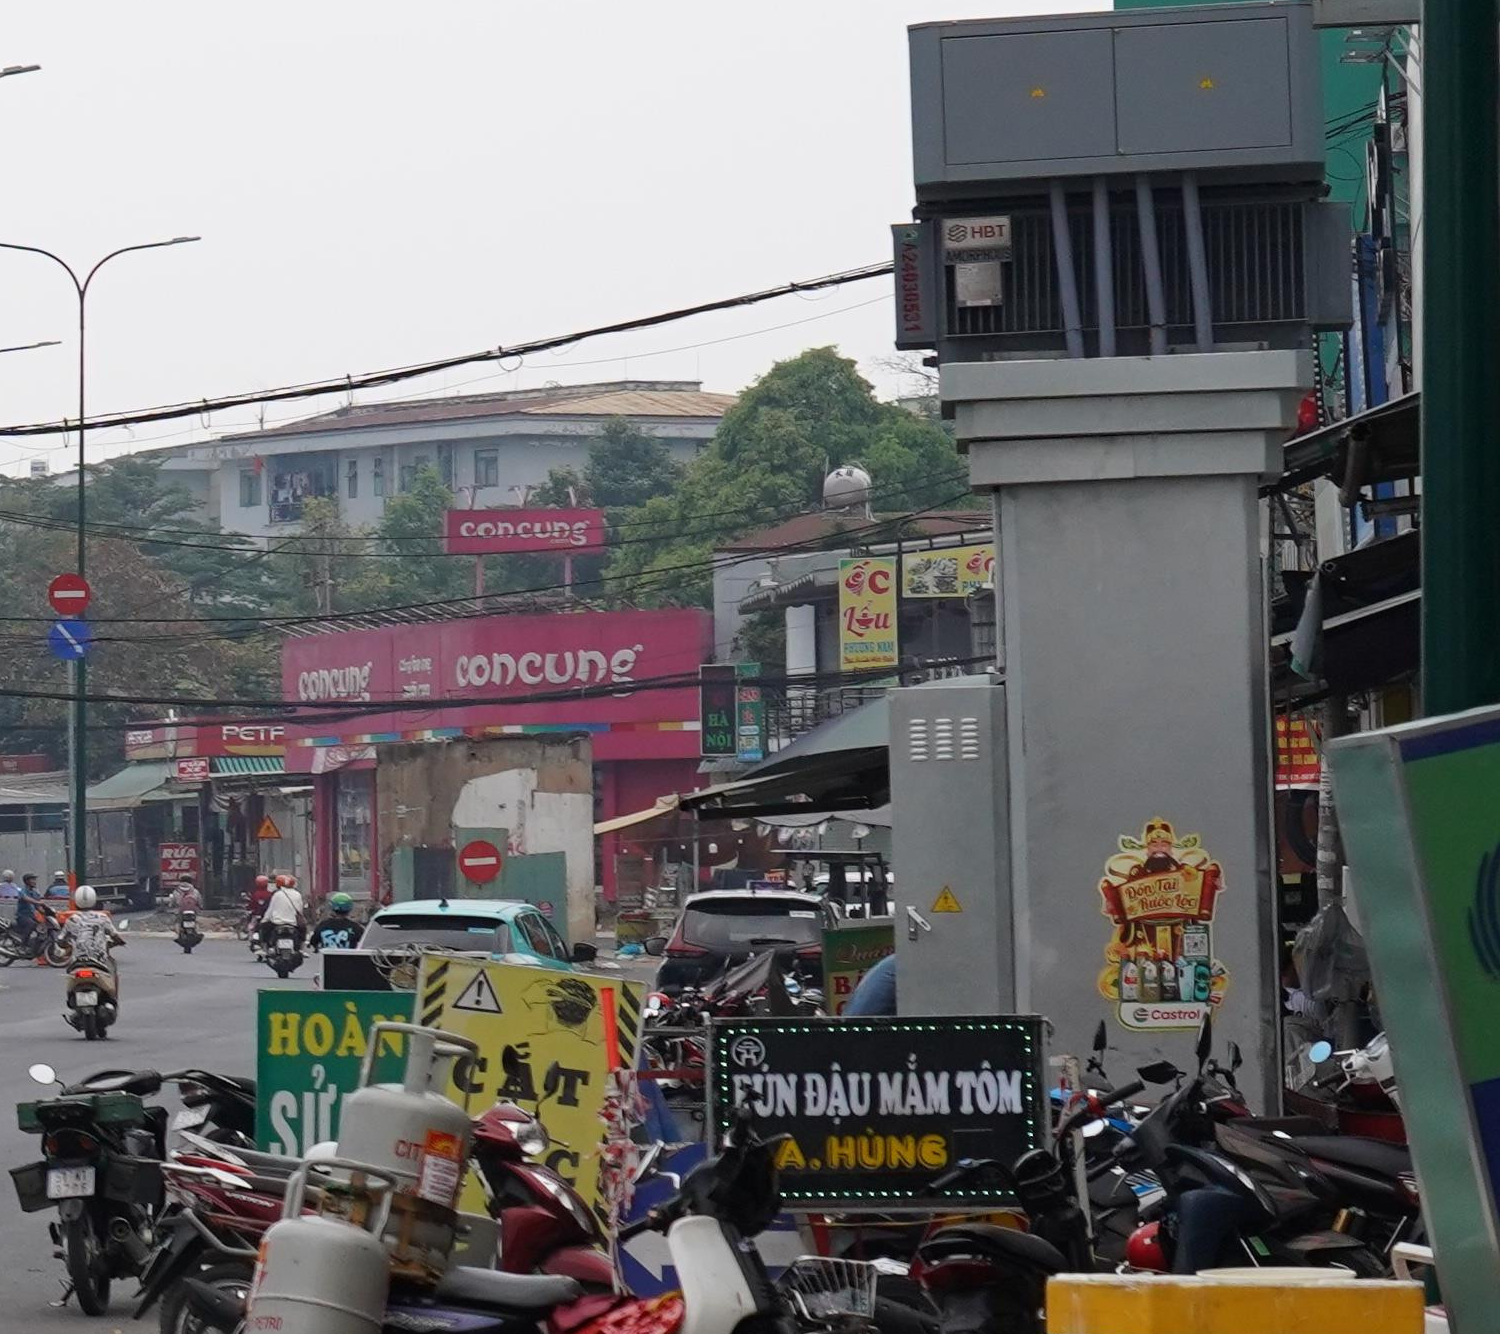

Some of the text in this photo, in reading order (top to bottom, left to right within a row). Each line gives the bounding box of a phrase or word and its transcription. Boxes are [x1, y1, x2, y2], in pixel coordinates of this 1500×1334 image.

[972, 224, 1006, 239] HBT
[1151, 1009, 1201, 1021] Castrol
[804, 1061, 872, 1125] ĐẬU
[876, 1052, 950, 1116] MẮM
[955, 1059, 1023, 1115] TÔM
[825, 1126, 949, 1171] HÙNG
